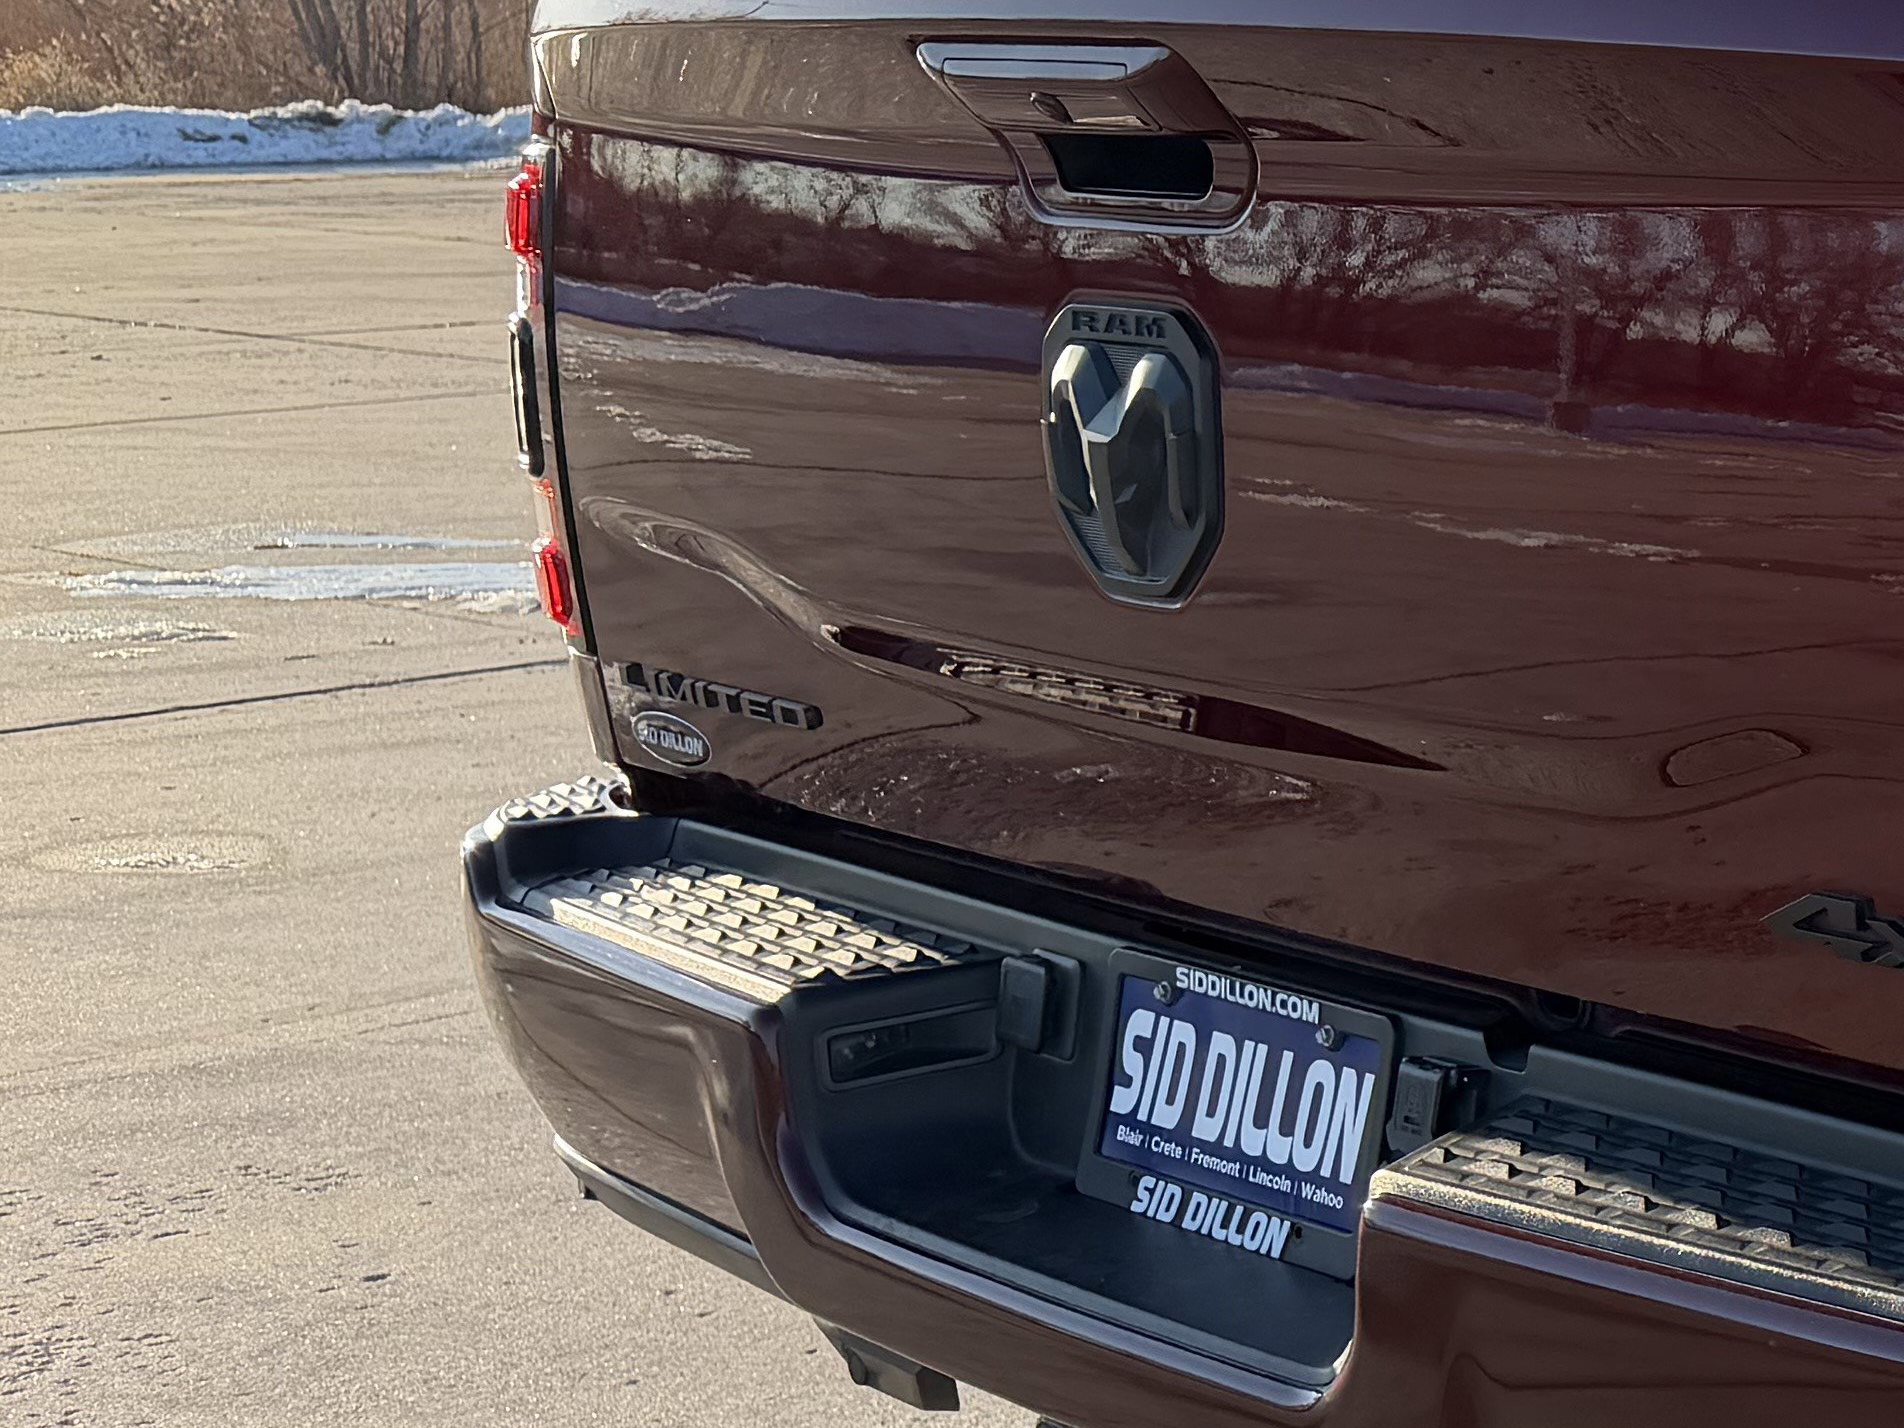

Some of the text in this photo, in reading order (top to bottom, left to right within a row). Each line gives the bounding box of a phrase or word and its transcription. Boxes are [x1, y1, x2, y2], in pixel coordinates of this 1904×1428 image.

[1071, 310, 1167, 339] RAM
[617, 661, 824, 731] LIMITED
[660, 729, 704, 757] DILLON
[1175, 966, 1321, 1025] SIDDILLON.COM
[1109, 1008, 1376, 1185] SID DILLON
[1116, 1124, 1344, 1210] Blair Crete Fremont Lincoln Wahoo
[1130, 1175, 1291, 1259] SID DILLON
